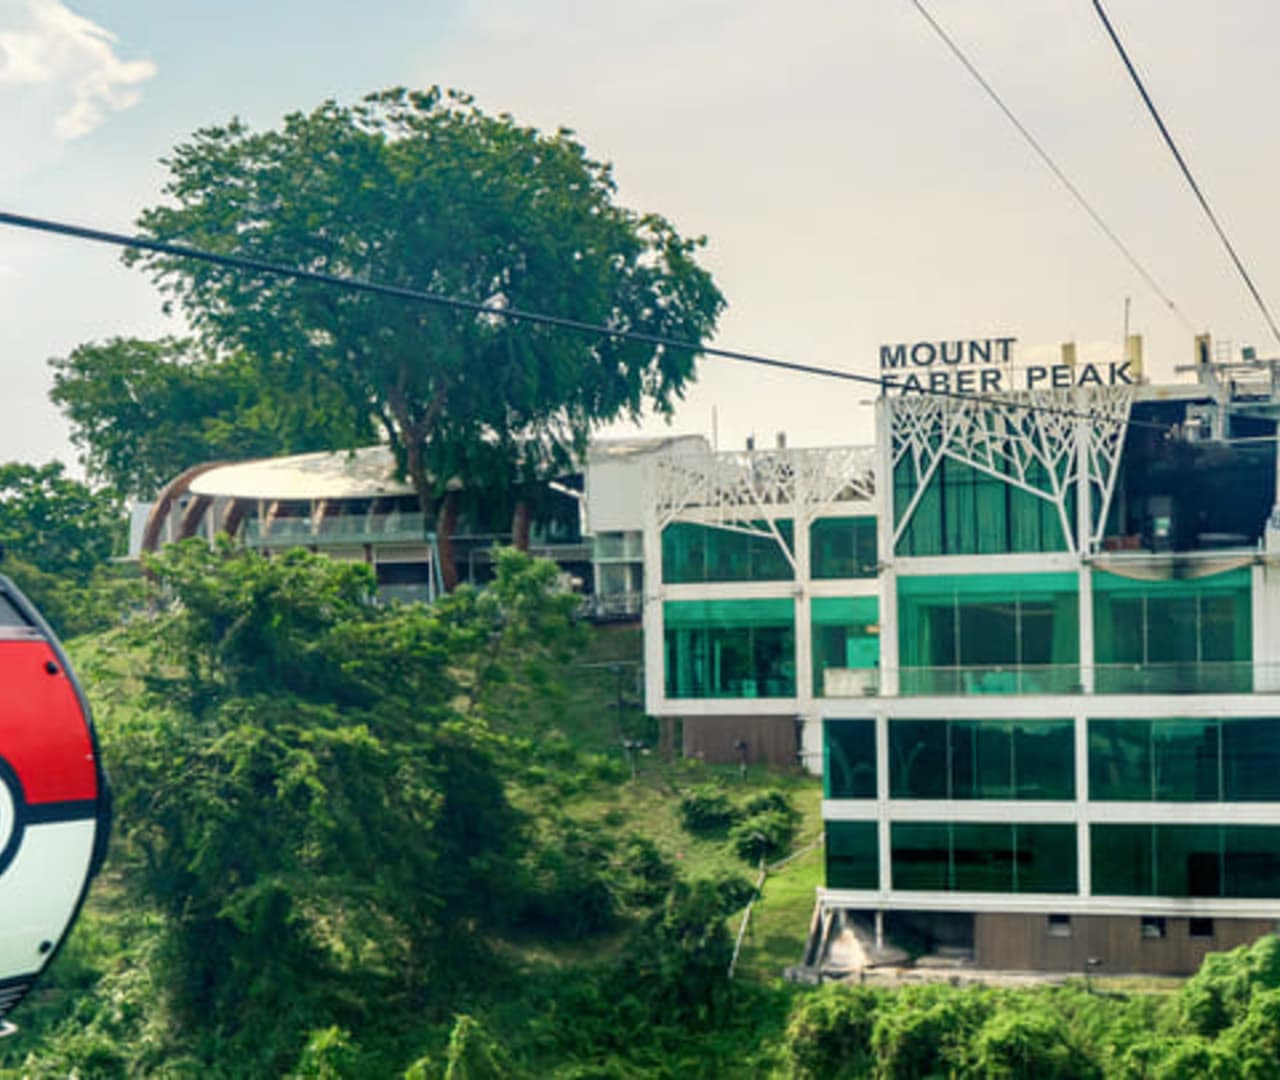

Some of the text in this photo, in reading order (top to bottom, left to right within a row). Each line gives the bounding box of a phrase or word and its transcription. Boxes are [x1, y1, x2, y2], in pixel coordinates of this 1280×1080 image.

[880, 338, 1017, 368] MOUNT
[880, 361, 1133, 396] FABER PEAK
